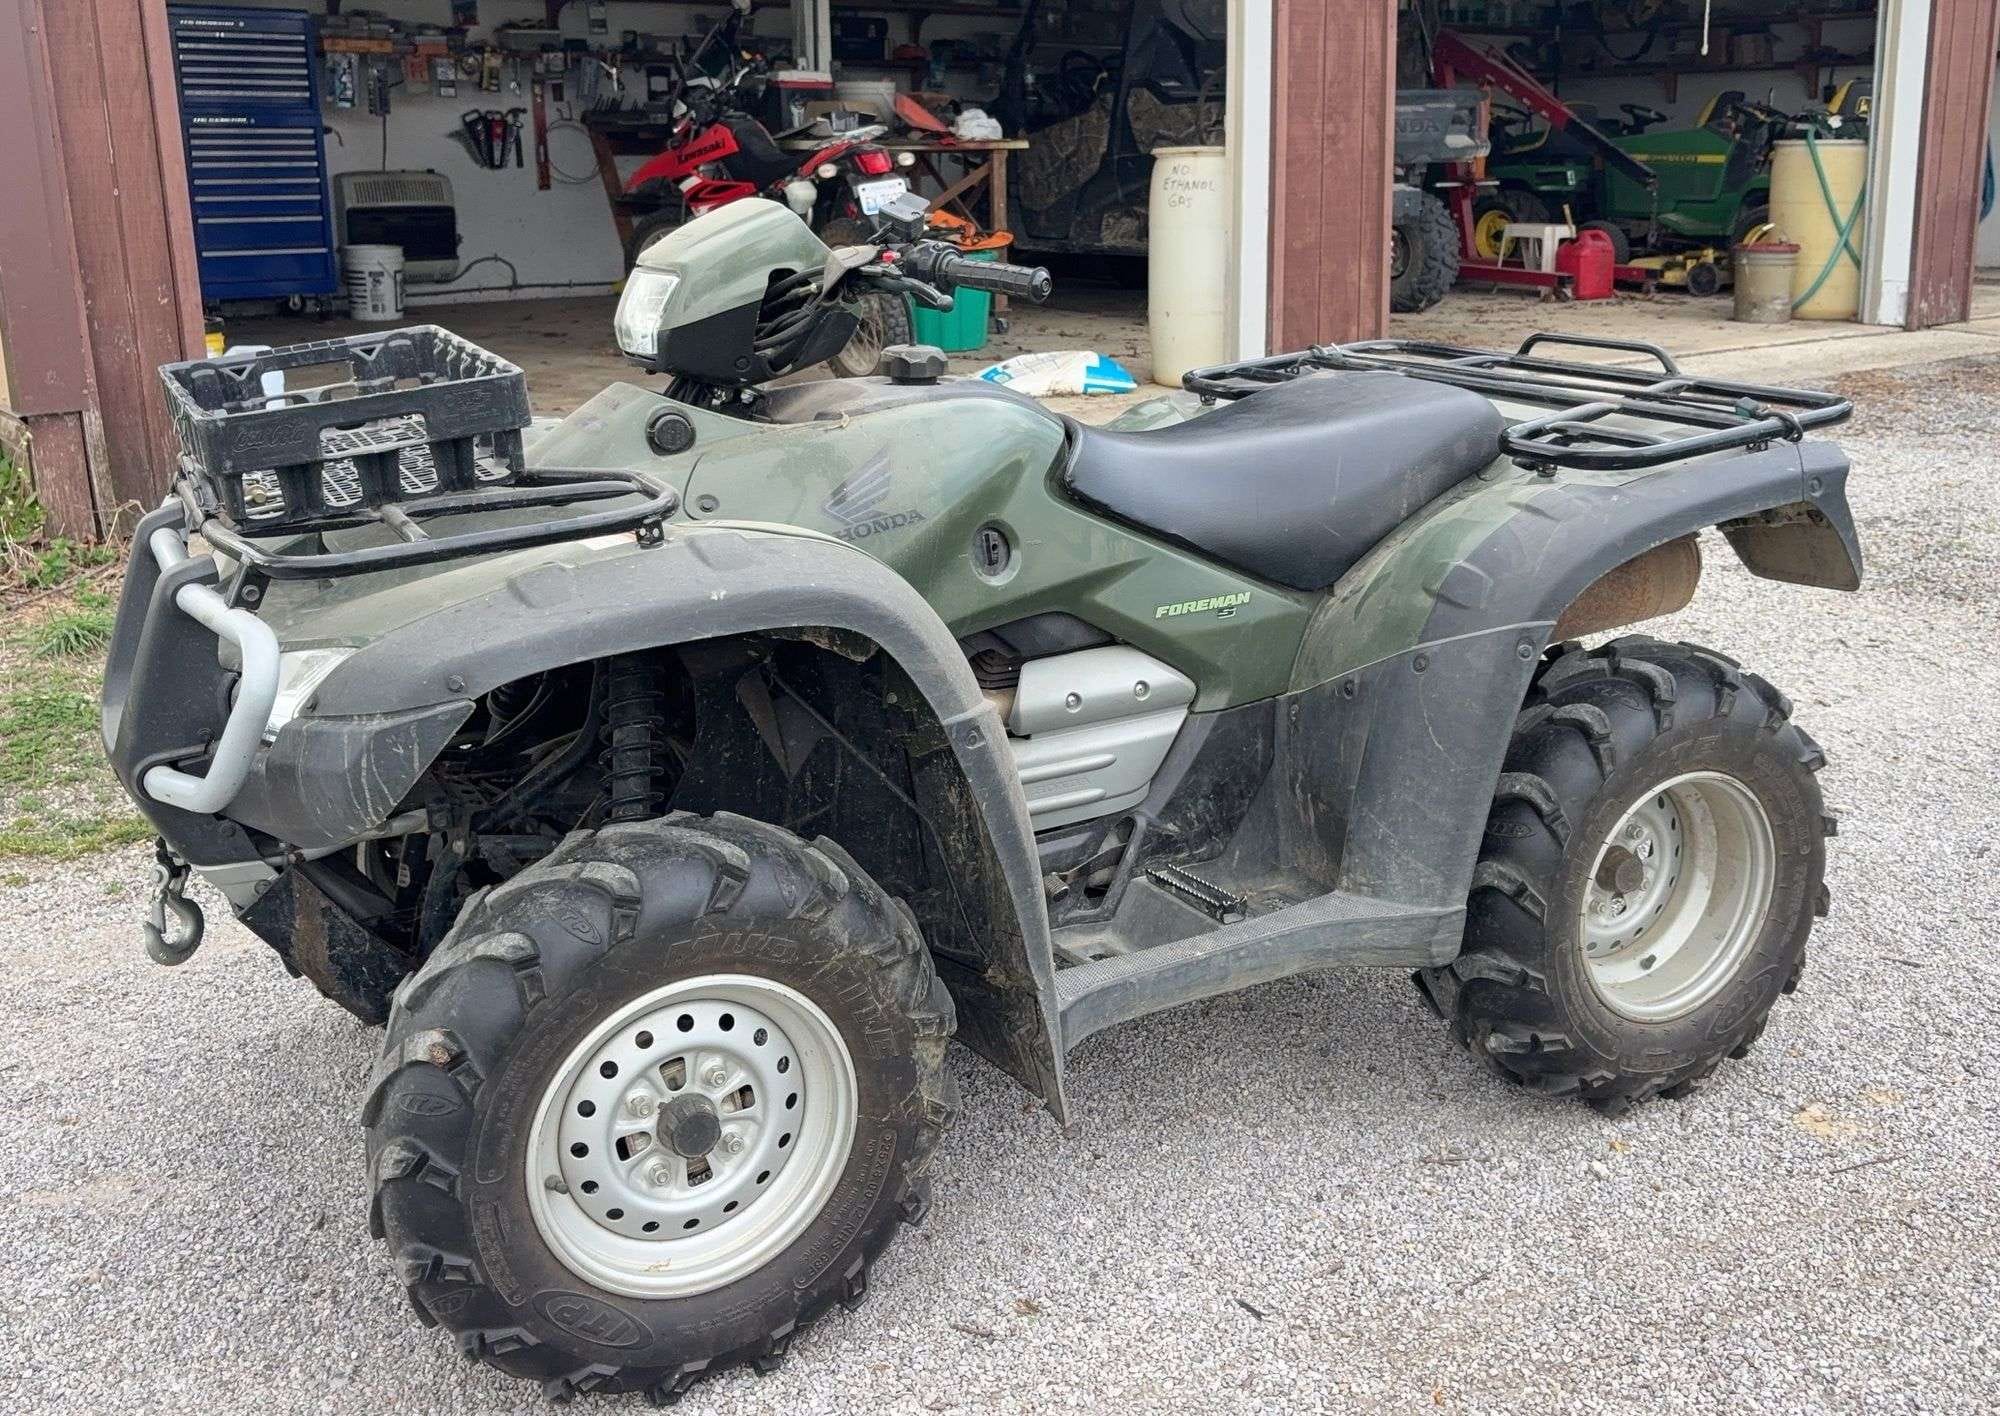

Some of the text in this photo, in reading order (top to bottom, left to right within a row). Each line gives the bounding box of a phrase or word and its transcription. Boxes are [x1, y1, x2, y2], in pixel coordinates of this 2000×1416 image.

[1163, 178, 1216, 192] ETHANOL
[832, 509, 927, 541] HONDA
[1155, 591, 1251, 619] FOREMAN
